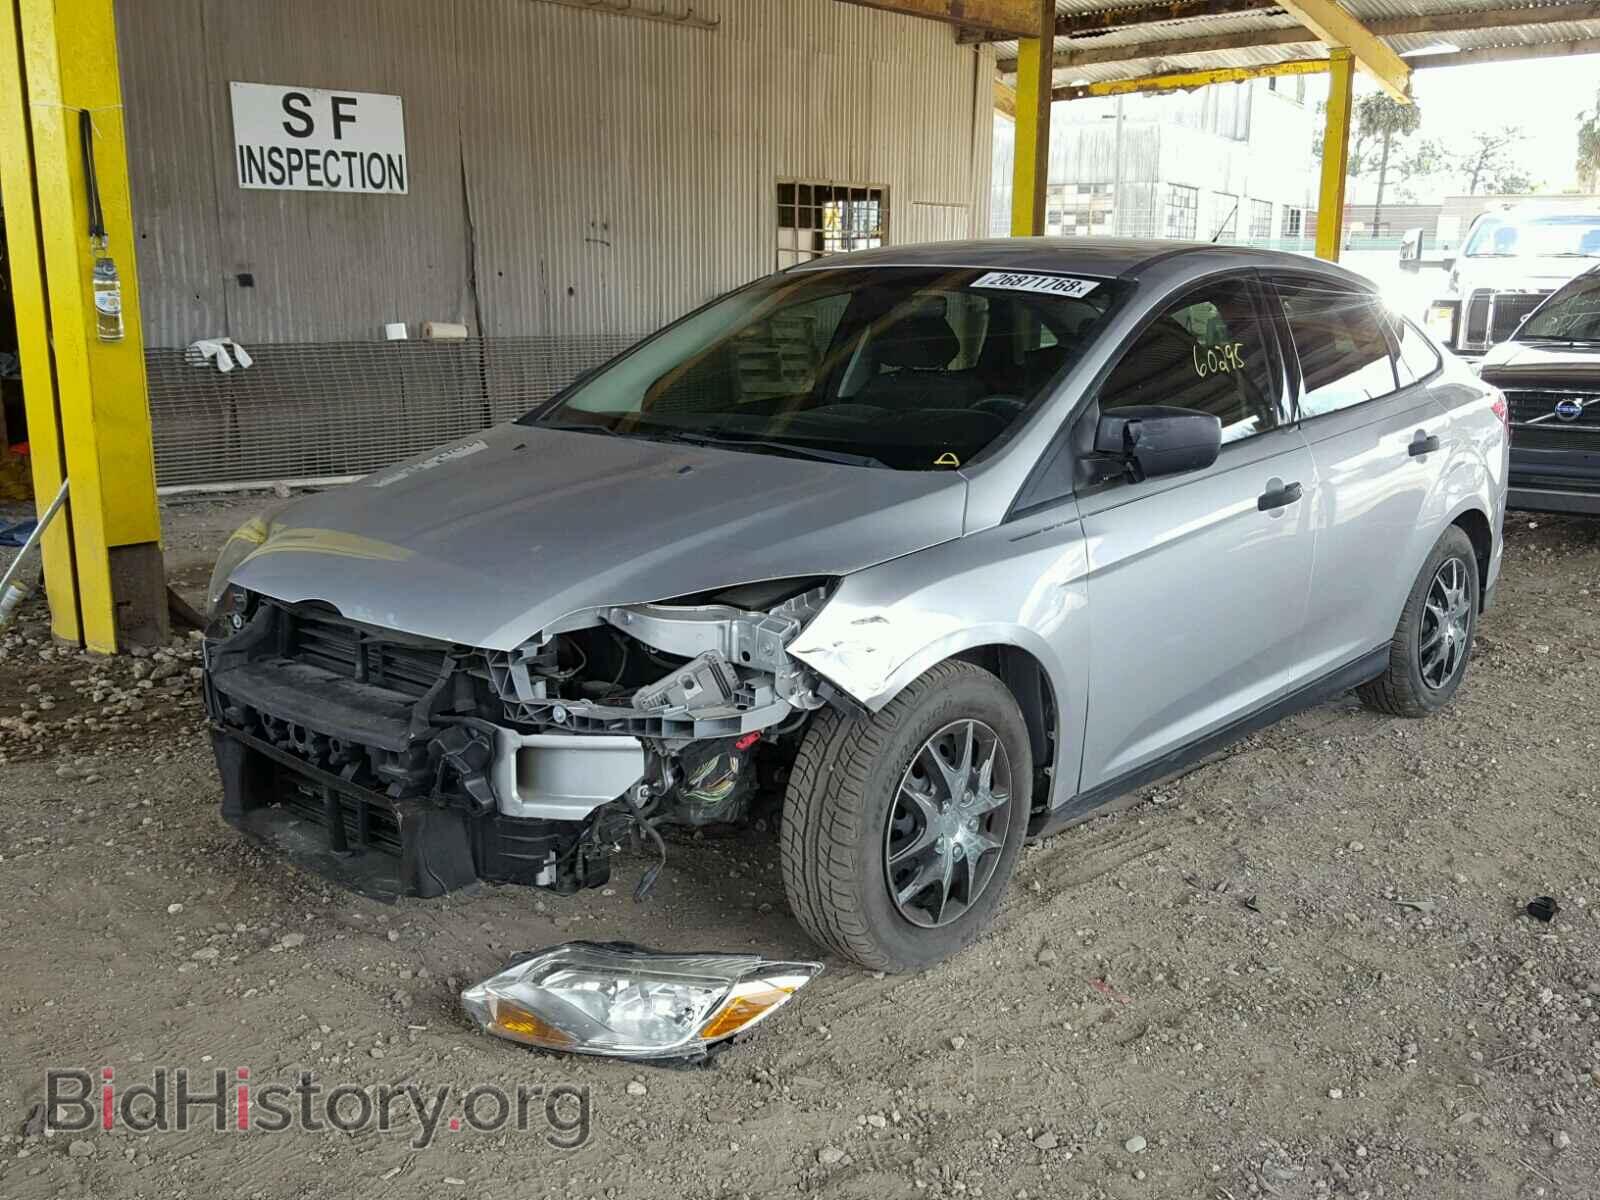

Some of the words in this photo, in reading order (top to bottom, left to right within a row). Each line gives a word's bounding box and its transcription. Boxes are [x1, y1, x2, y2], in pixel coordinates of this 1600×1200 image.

[282, 92, 315, 138] S
[331, 96, 358, 140] F
[238, 145, 404, 191] INSPECTION
[1193, 343, 1245, 377] 60295
